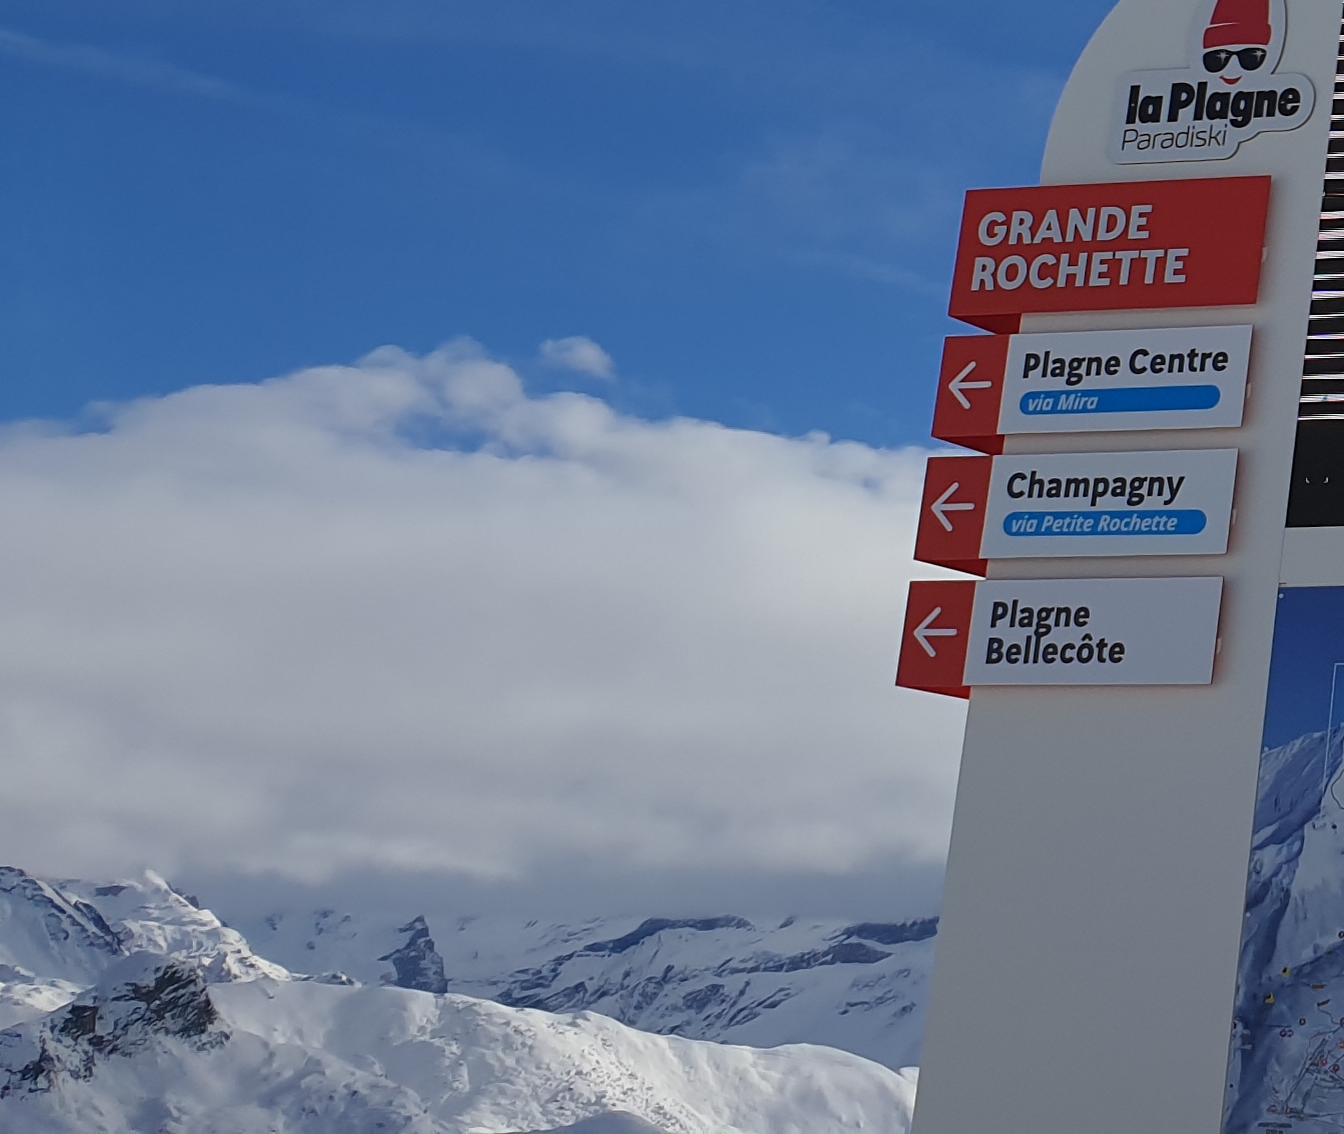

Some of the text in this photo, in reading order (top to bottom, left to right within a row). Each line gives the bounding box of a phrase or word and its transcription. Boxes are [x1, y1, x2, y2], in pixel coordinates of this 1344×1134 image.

[1125, 80, 1301, 128] la Plagne
[1121, 124, 1228, 152] Paradiski
[978, 205, 1153, 246] GRANDE
[970, 248, 1189, 292] ROCHETTE
[1022, 348, 1228, 386] Plagne Centre
[1027, 393, 1099, 411] via Mira
[1006, 471, 1185, 507] Champagny
[1011, 513, 1178, 533] via Petite Rochette
[990, 600, 1090, 636] Plagne
[985, 633, 1126, 665] Bellecôte
